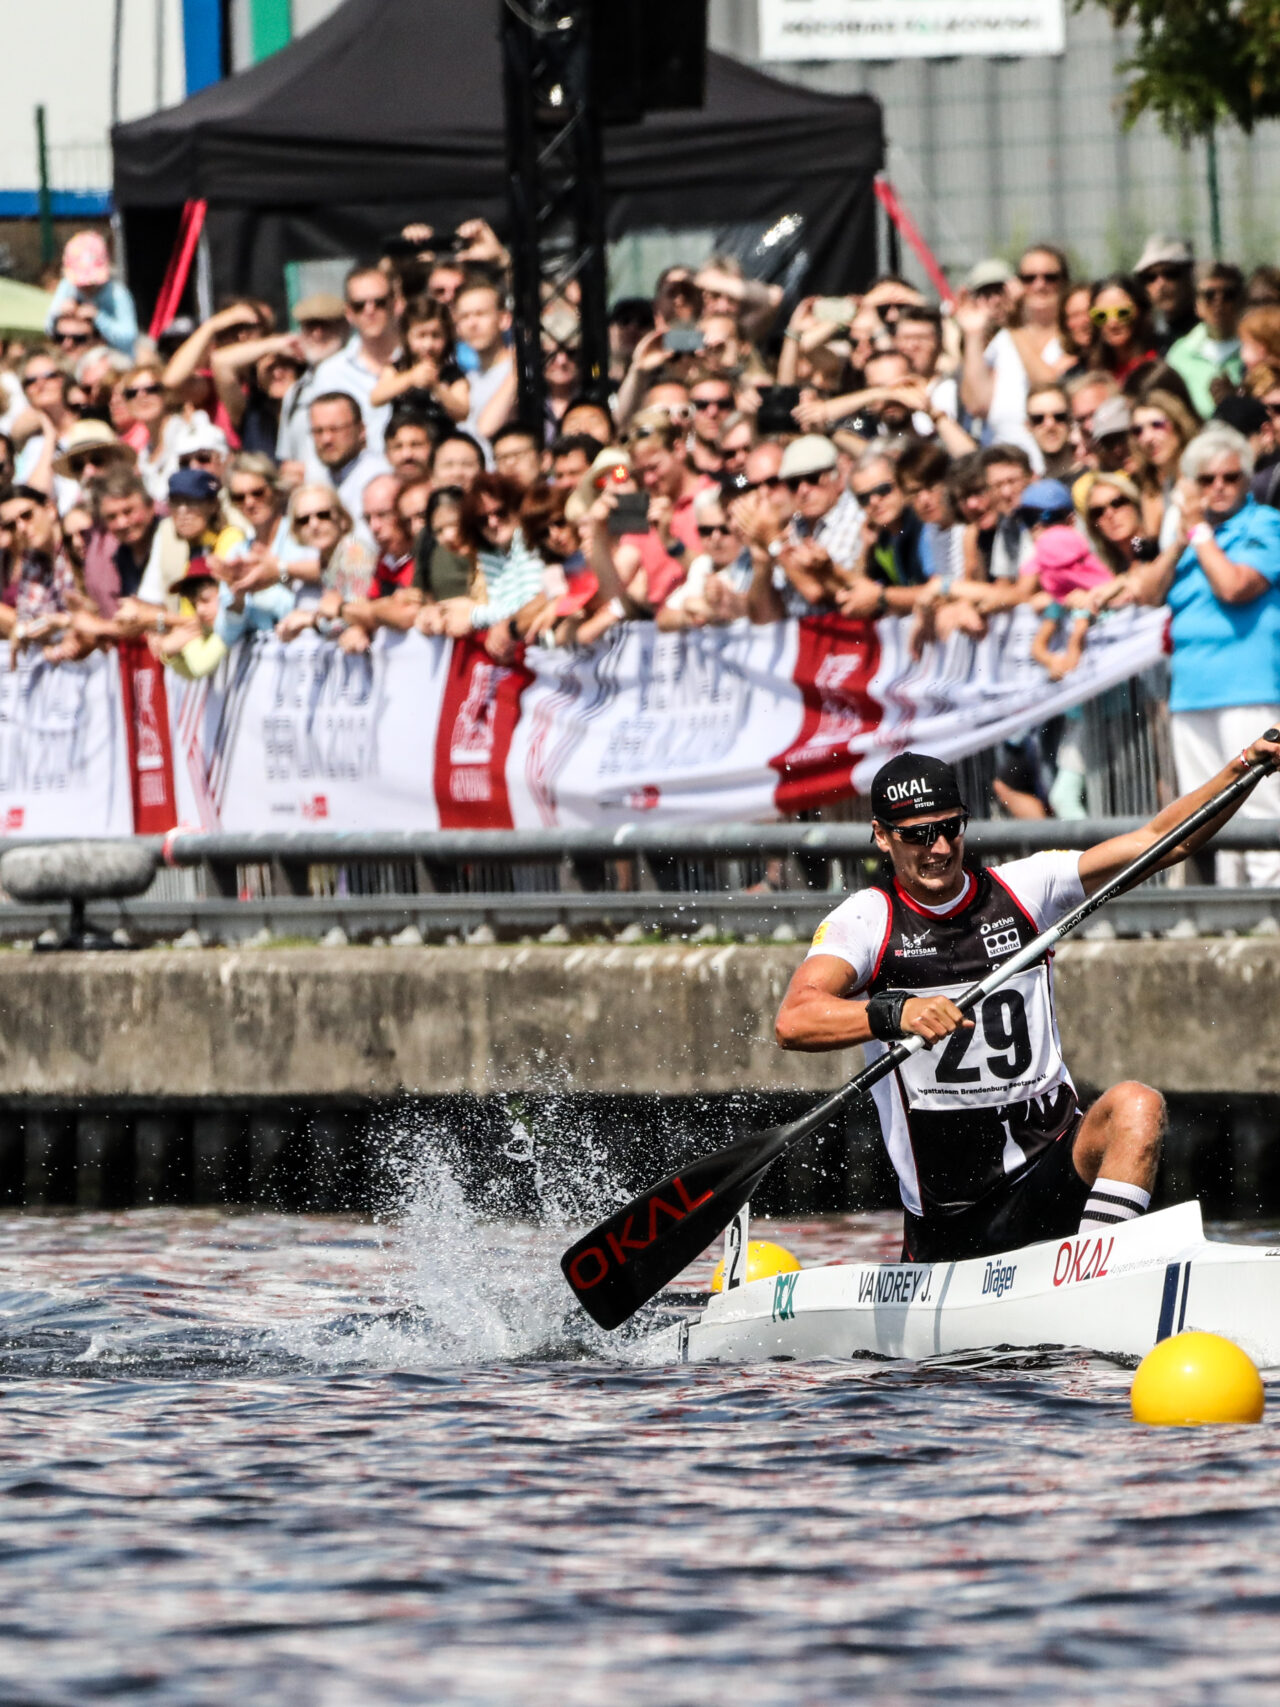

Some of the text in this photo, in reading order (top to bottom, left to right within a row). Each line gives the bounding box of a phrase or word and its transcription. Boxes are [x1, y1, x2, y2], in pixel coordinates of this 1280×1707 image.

[886, 777, 933, 801] OKAL
[991, 917, 1015, 929] artiva
[907, 947, 937, 955] POTSDAM
[989, 942, 1020, 955] SECURITAS
[935, 989, 1033, 1084] 29
[569, 1176, 715, 1290] OKAL
[727, 1214, 742, 1291] 2
[857, 1271, 919, 1303] VANDREY
[921, 1271, 932, 1301] J.
[981, 1260, 1018, 1298] Dräger
[1052, 1236, 1115, 1287] OKAL
